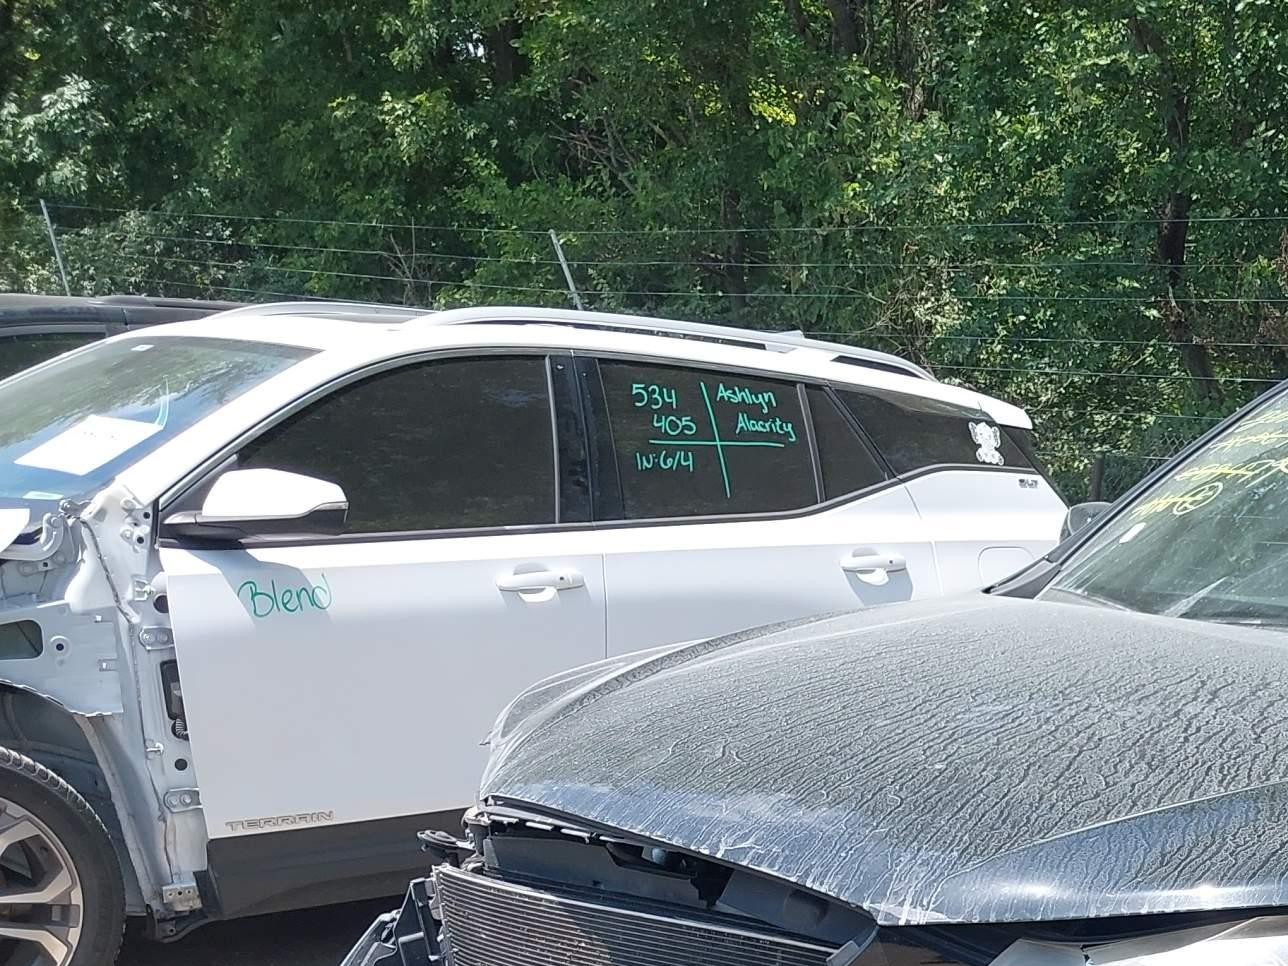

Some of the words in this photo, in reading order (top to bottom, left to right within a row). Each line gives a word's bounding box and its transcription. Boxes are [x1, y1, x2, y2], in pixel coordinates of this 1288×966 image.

[631, 383, 677, 409] 534
[716, 383, 776, 413] Ashlyn
[653, 414, 697, 436] 405
[735, 412, 797, 442] Alacrity
[237, 572, 333, 619] Blend
[224, 810, 335, 832] TERRAIN
